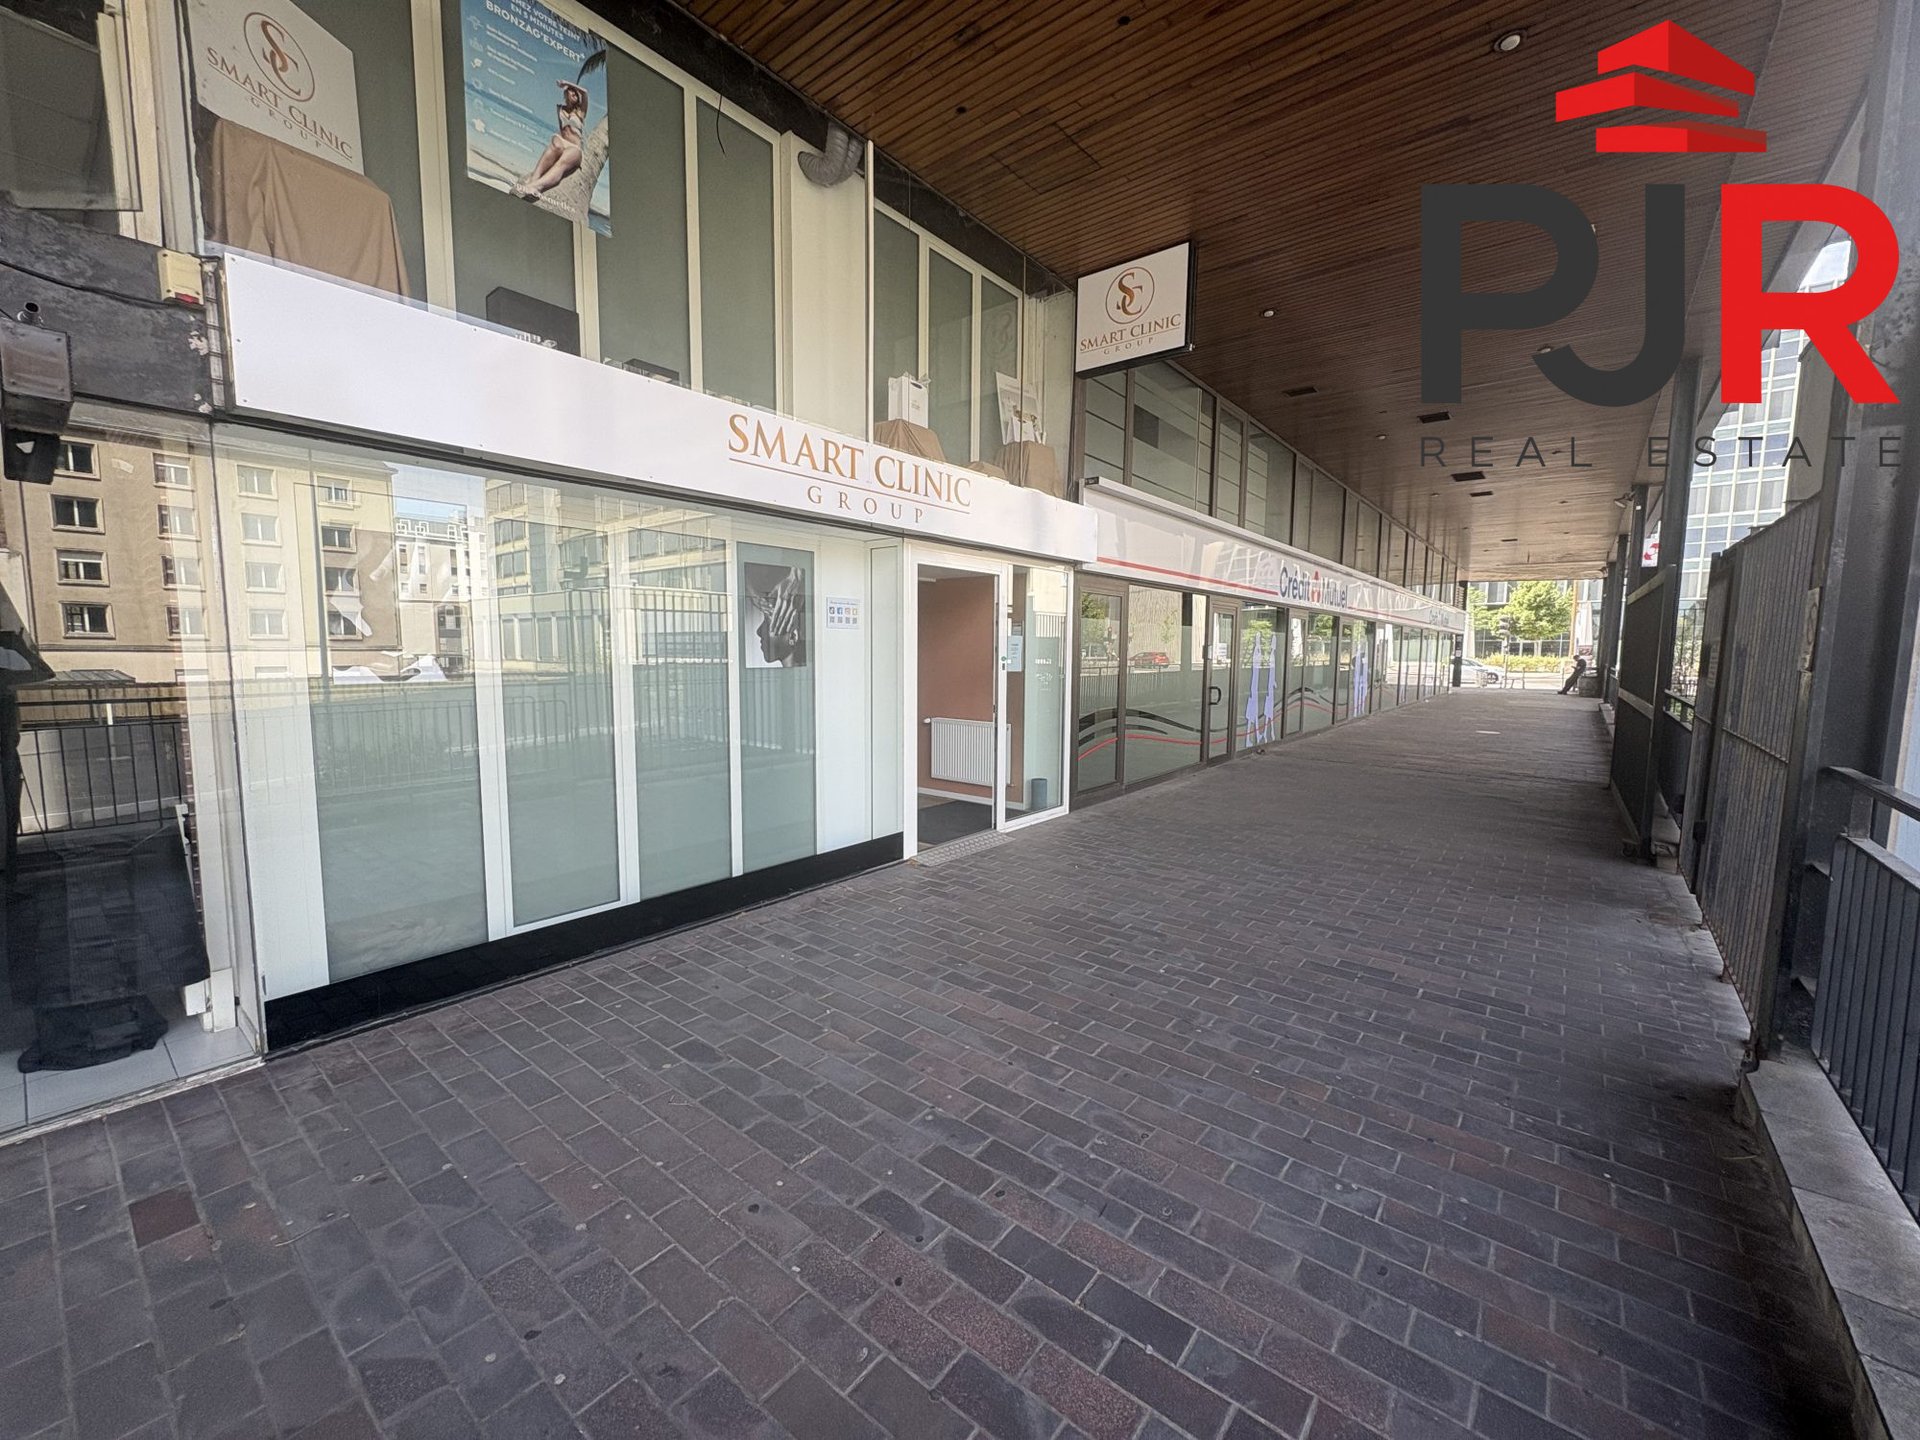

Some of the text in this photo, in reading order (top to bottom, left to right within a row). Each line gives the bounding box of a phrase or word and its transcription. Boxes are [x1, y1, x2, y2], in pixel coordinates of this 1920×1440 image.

[510, 2, 522, 15] EN
[529, 15, 565, 40] MINUTES
[207, 47, 353, 159] SMART CLINIC
[250, 96, 322, 149] GROUP
[1080, 313, 1181, 351] SMART CLINIC
[1103, 337, 1154, 355] GROUP
[728, 413, 971, 507] SMART CLINIC
[807, 485, 924, 523] GROUP
[1279, 566, 1311, 602] Crédit
